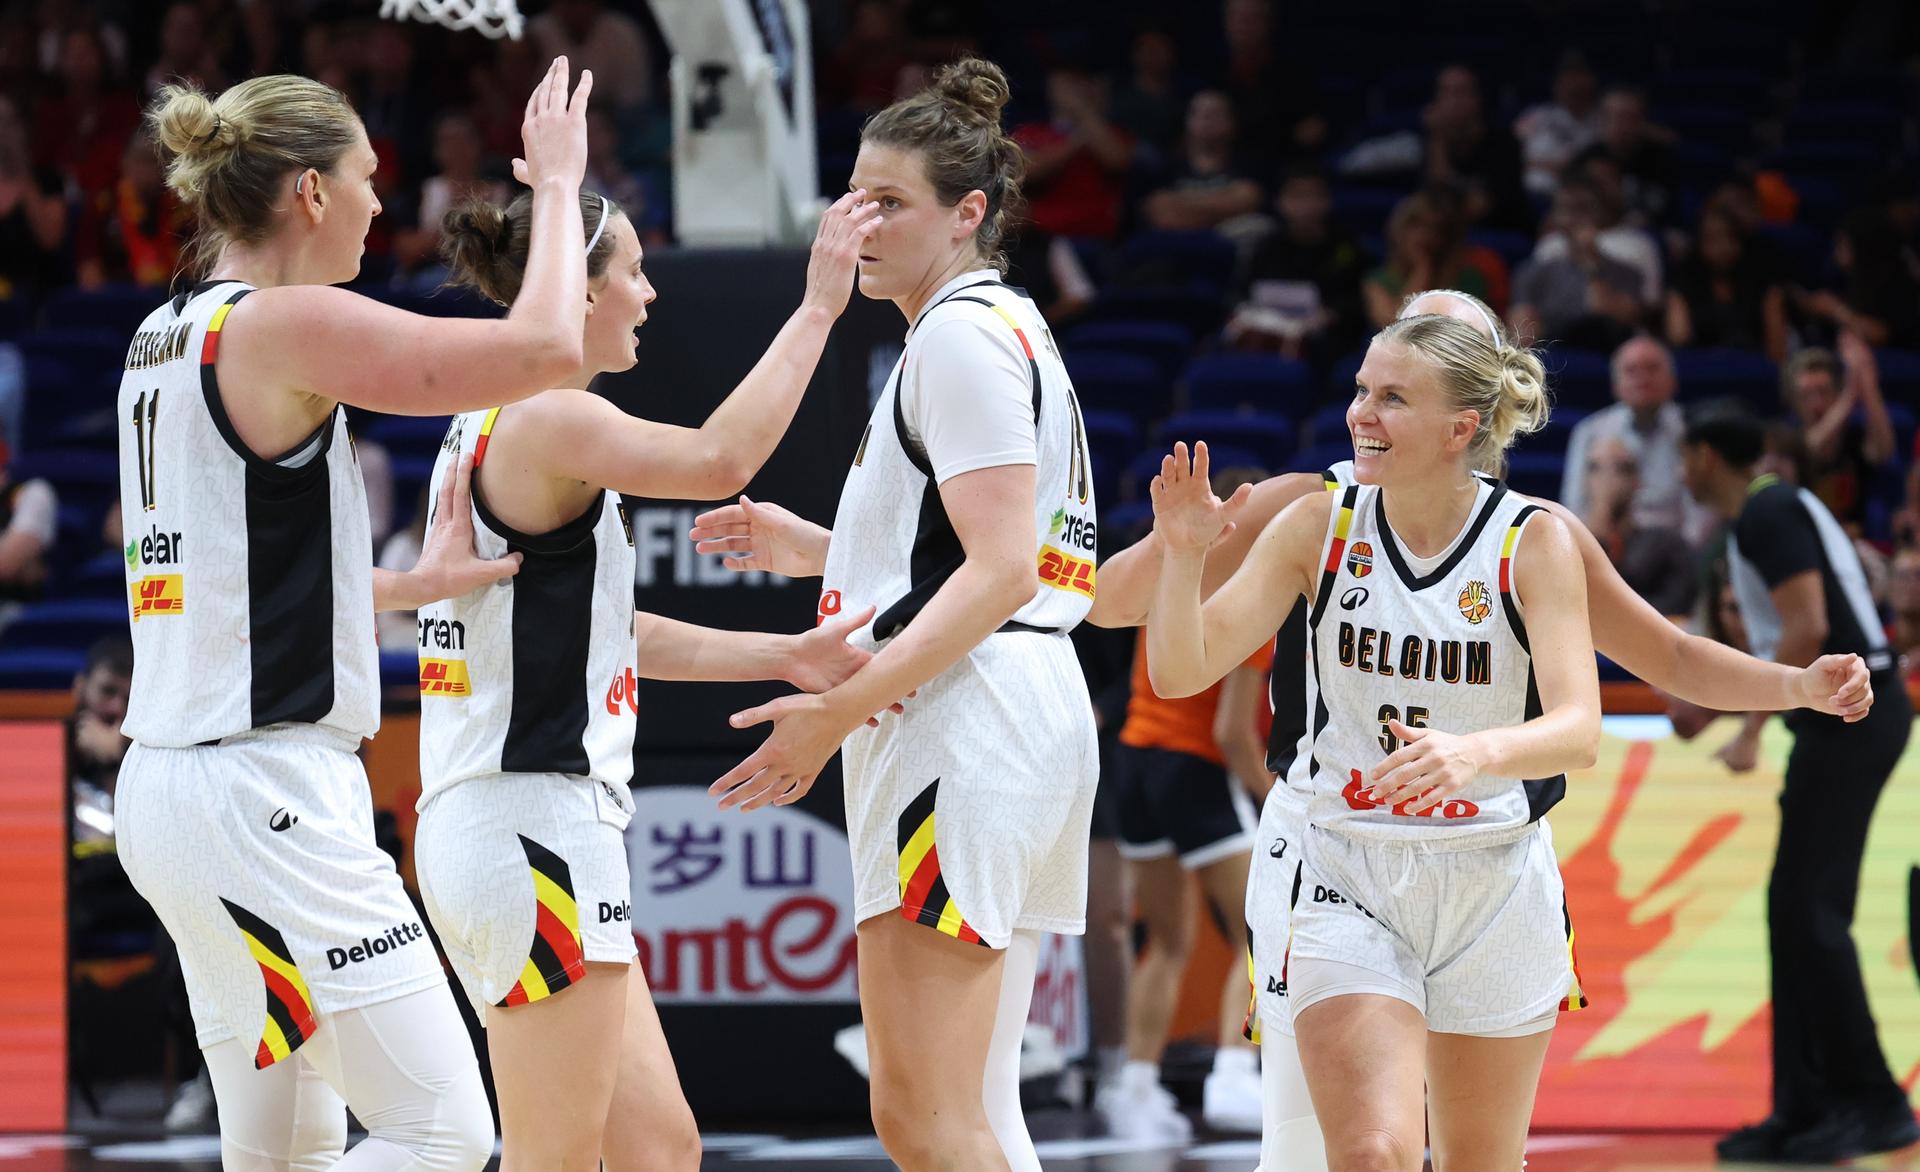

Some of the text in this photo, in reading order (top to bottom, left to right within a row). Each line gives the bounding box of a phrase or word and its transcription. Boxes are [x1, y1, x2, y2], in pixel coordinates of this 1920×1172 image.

[133, 388, 160, 513] 11
[634, 508, 797, 586] FI
[1038, 552, 1096, 596] DHL
[1338, 621, 1491, 685] BELGIUM
[640, 820, 816, 895] 岁山
[598, 899, 631, 924] Delo
[326, 922, 423, 971] Deloitte
